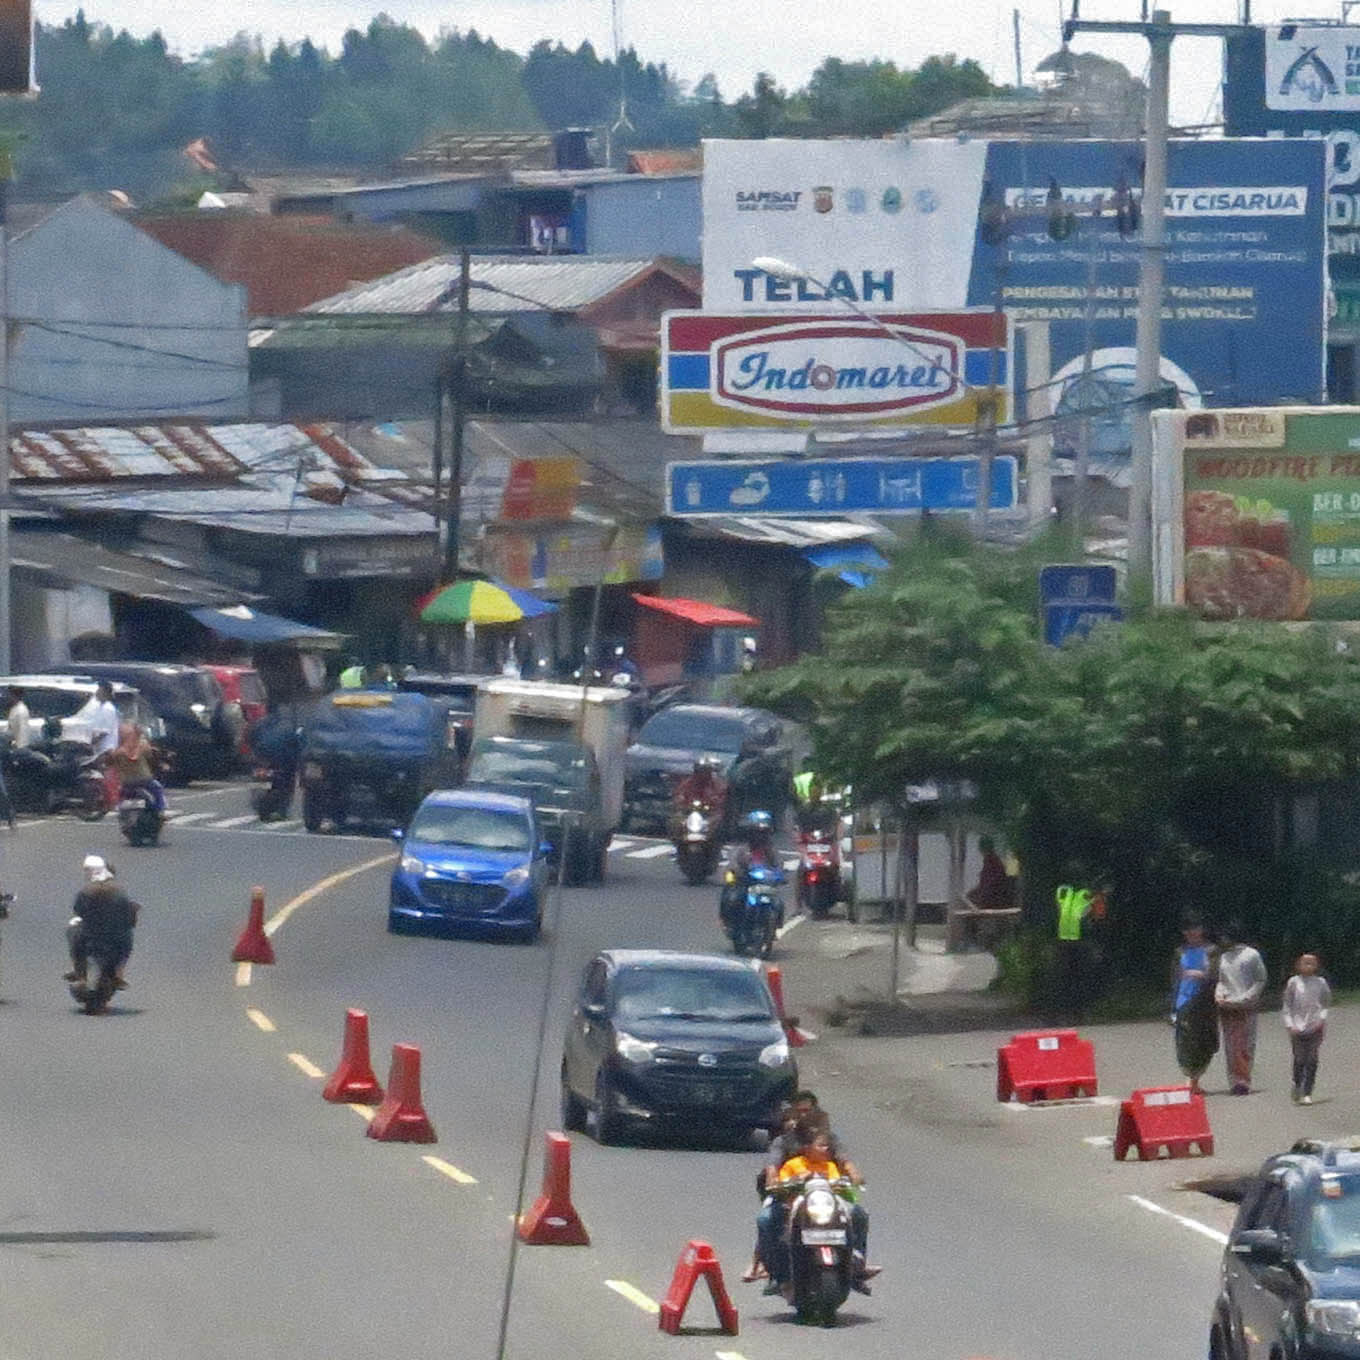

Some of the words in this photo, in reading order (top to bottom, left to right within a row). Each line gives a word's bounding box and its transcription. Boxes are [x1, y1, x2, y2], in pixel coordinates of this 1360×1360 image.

[1192, 193, 1300, 211] CISARUA
[734, 269, 895, 302] TELAH
[731, 351, 944, 390] Indomaret
